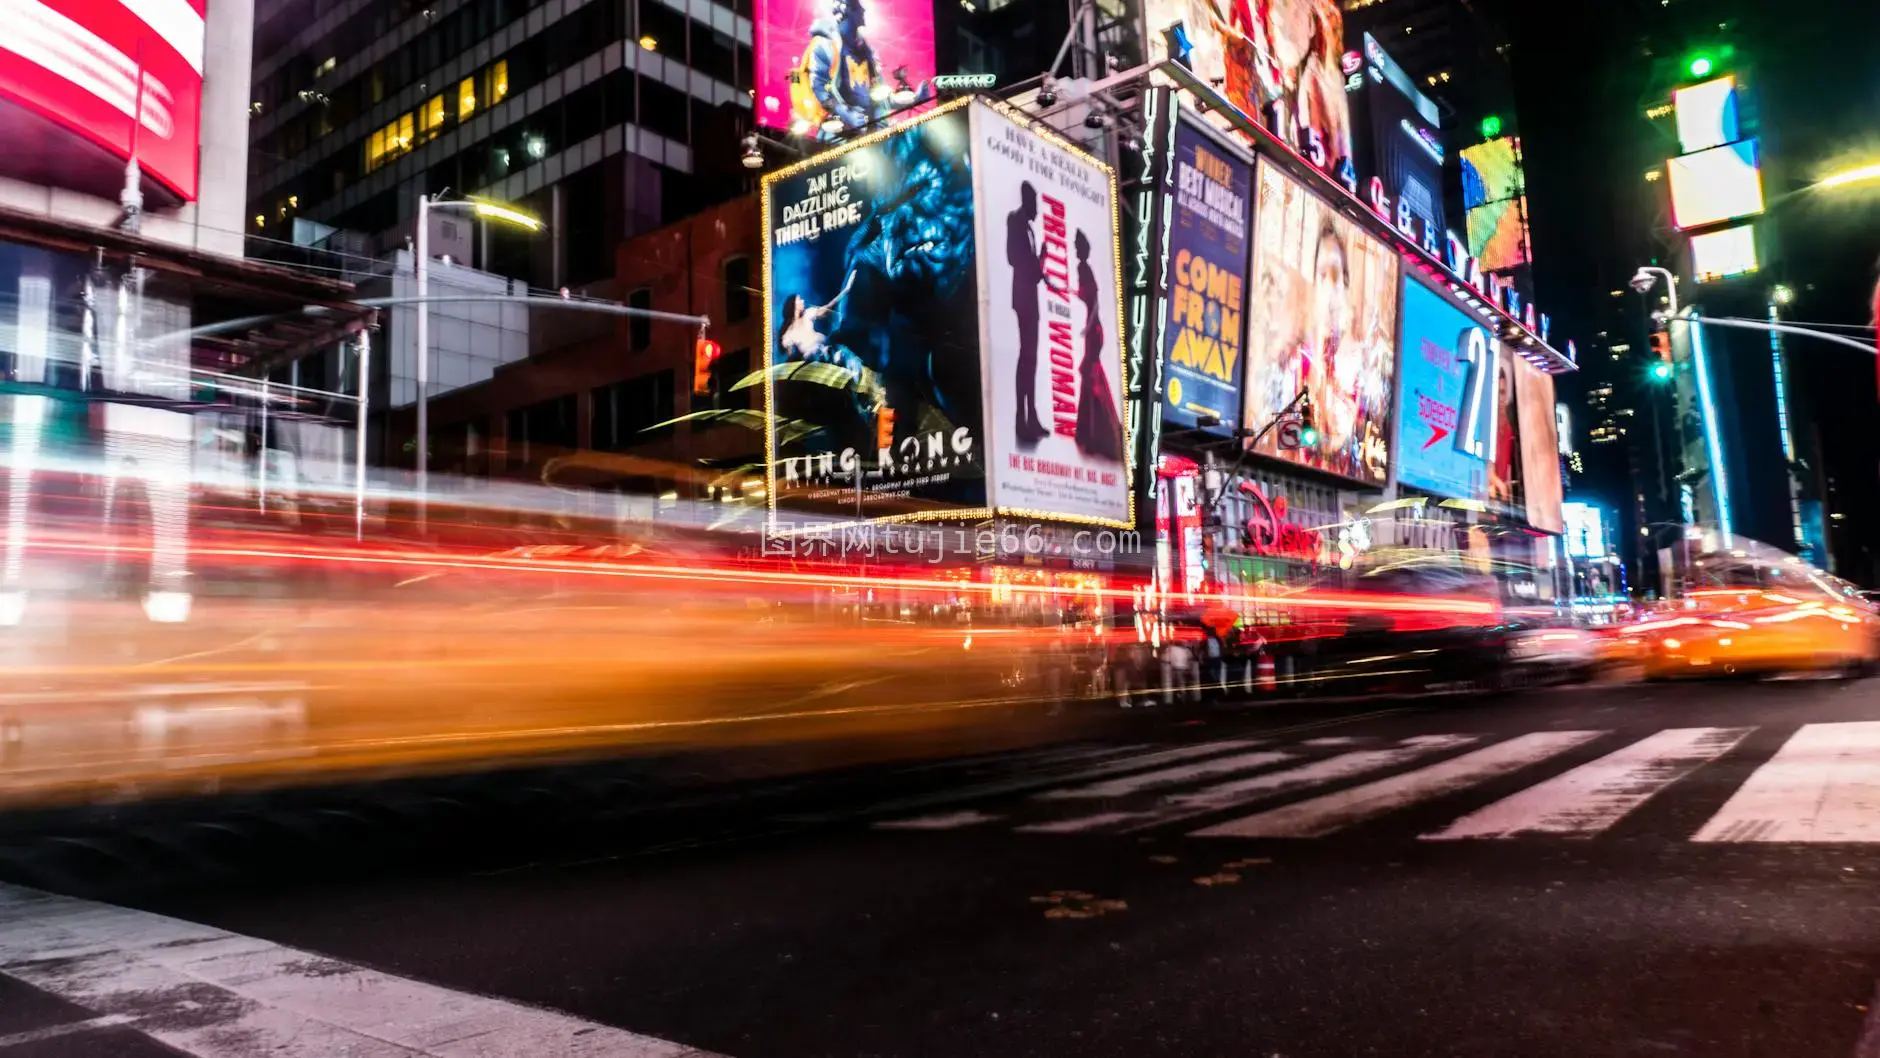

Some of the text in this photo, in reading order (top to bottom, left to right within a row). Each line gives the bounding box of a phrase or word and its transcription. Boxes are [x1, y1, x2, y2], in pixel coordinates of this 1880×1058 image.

[774, 216, 821, 249] THRILL
[783, 185, 851, 225] DAZZLING
[1041, 191, 1071, 305] PRETTY
[1175, 248, 1242, 312] COME
[1172, 283, 1240, 347] FROM
[1048, 320, 1078, 439] WOMAN
[1170, 327, 1238, 384] AWAY
[1455, 326, 1501, 464] 21
[785, 426, 973, 482] KING KONG
